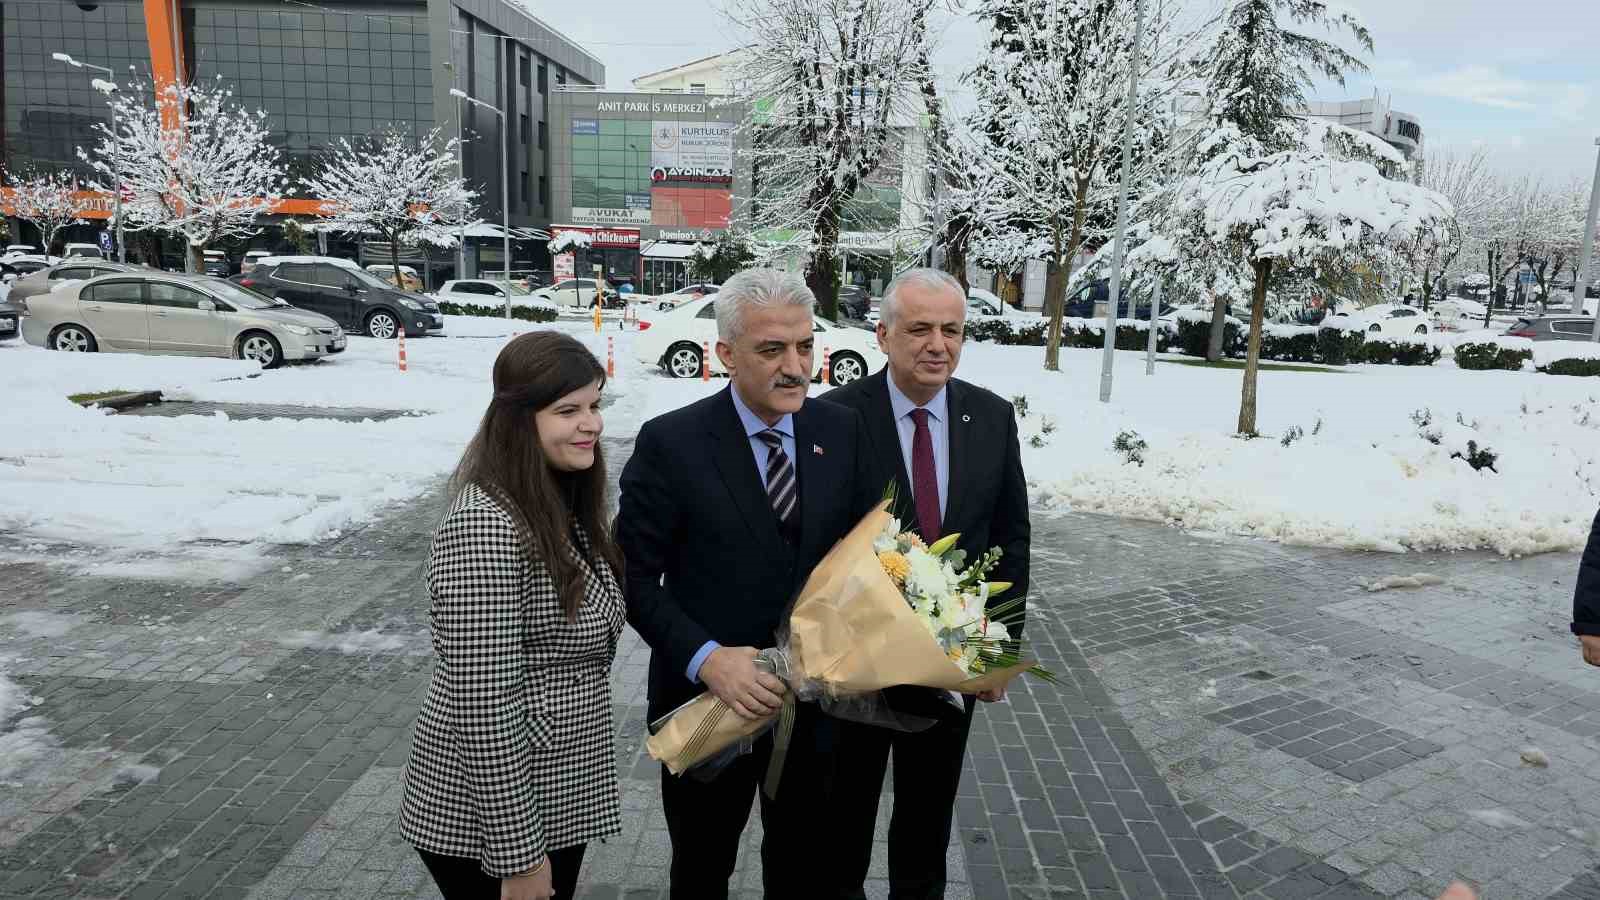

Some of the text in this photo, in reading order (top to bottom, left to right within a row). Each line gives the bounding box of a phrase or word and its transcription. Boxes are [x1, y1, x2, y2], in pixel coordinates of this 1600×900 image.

[624, 102, 649, 112] PARK
[588, 209, 633, 218] AVUKAT
[659, 229, 696, 240] Domino's
